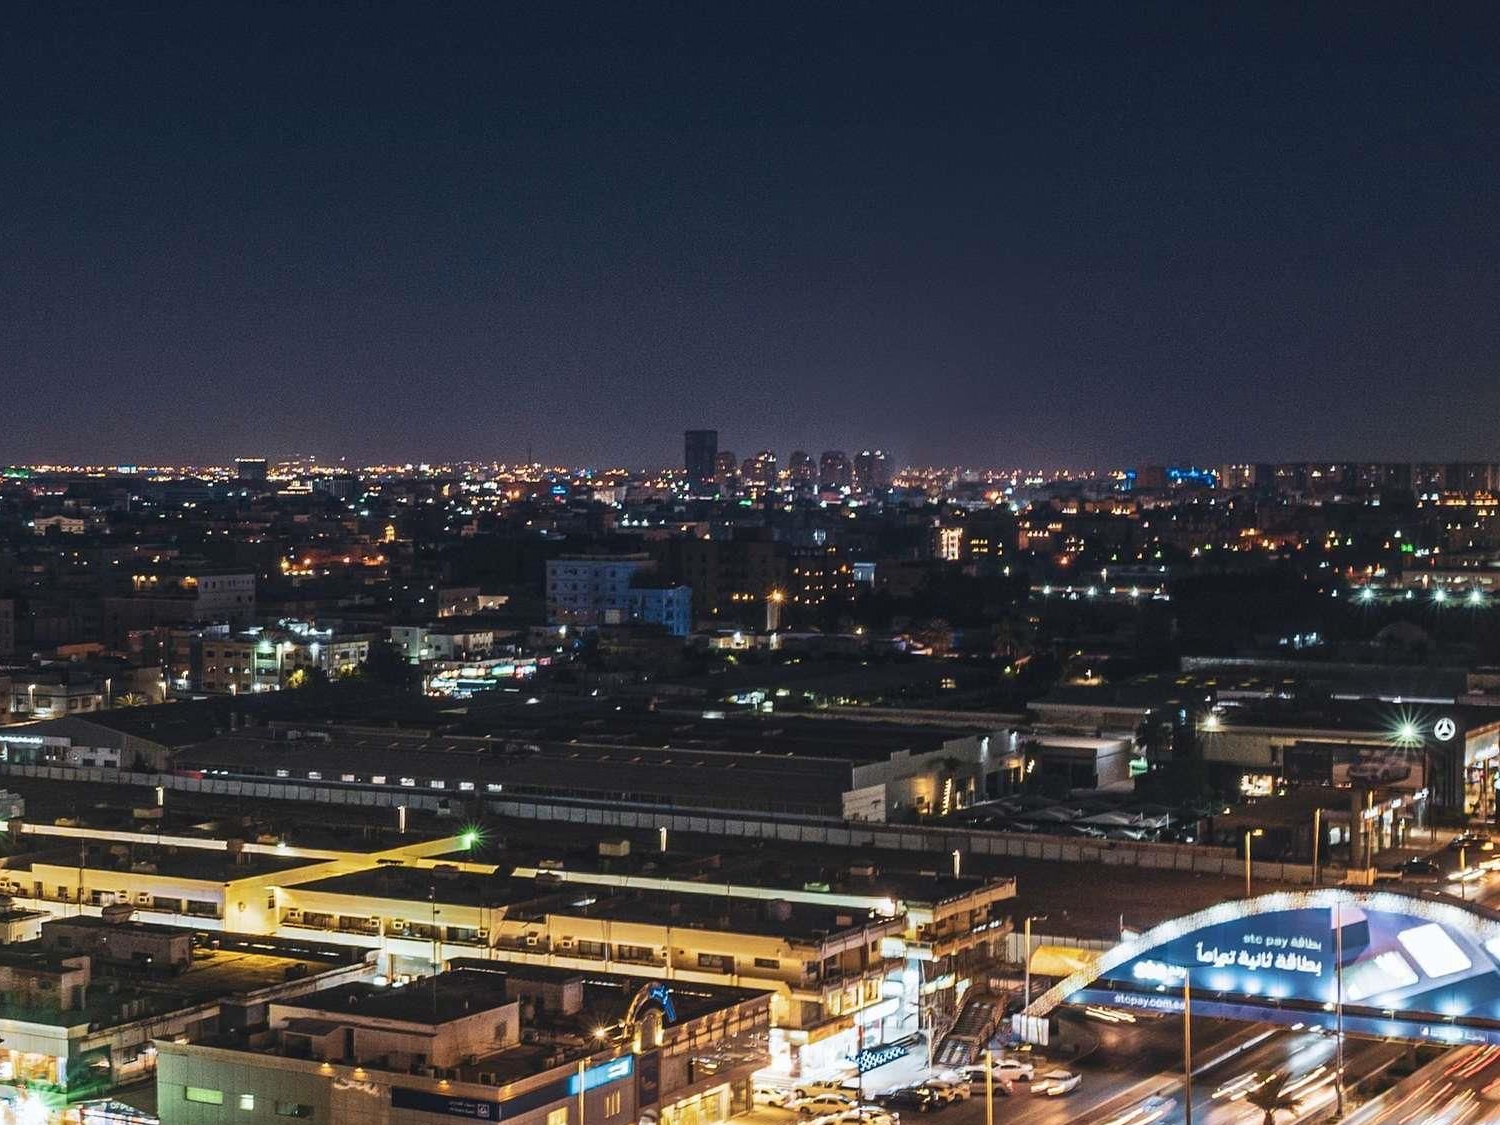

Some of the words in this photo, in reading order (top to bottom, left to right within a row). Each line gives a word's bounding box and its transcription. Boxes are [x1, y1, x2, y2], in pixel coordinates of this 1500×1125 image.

[1243, 934, 1263, 945] stc
[1266, 935, 1288, 949] pay
[1290, 936, 1322, 952] بطاقة
[1237, 950, 1274, 970] ثانية
[1275, 953, 1322, 977] بطاقة
